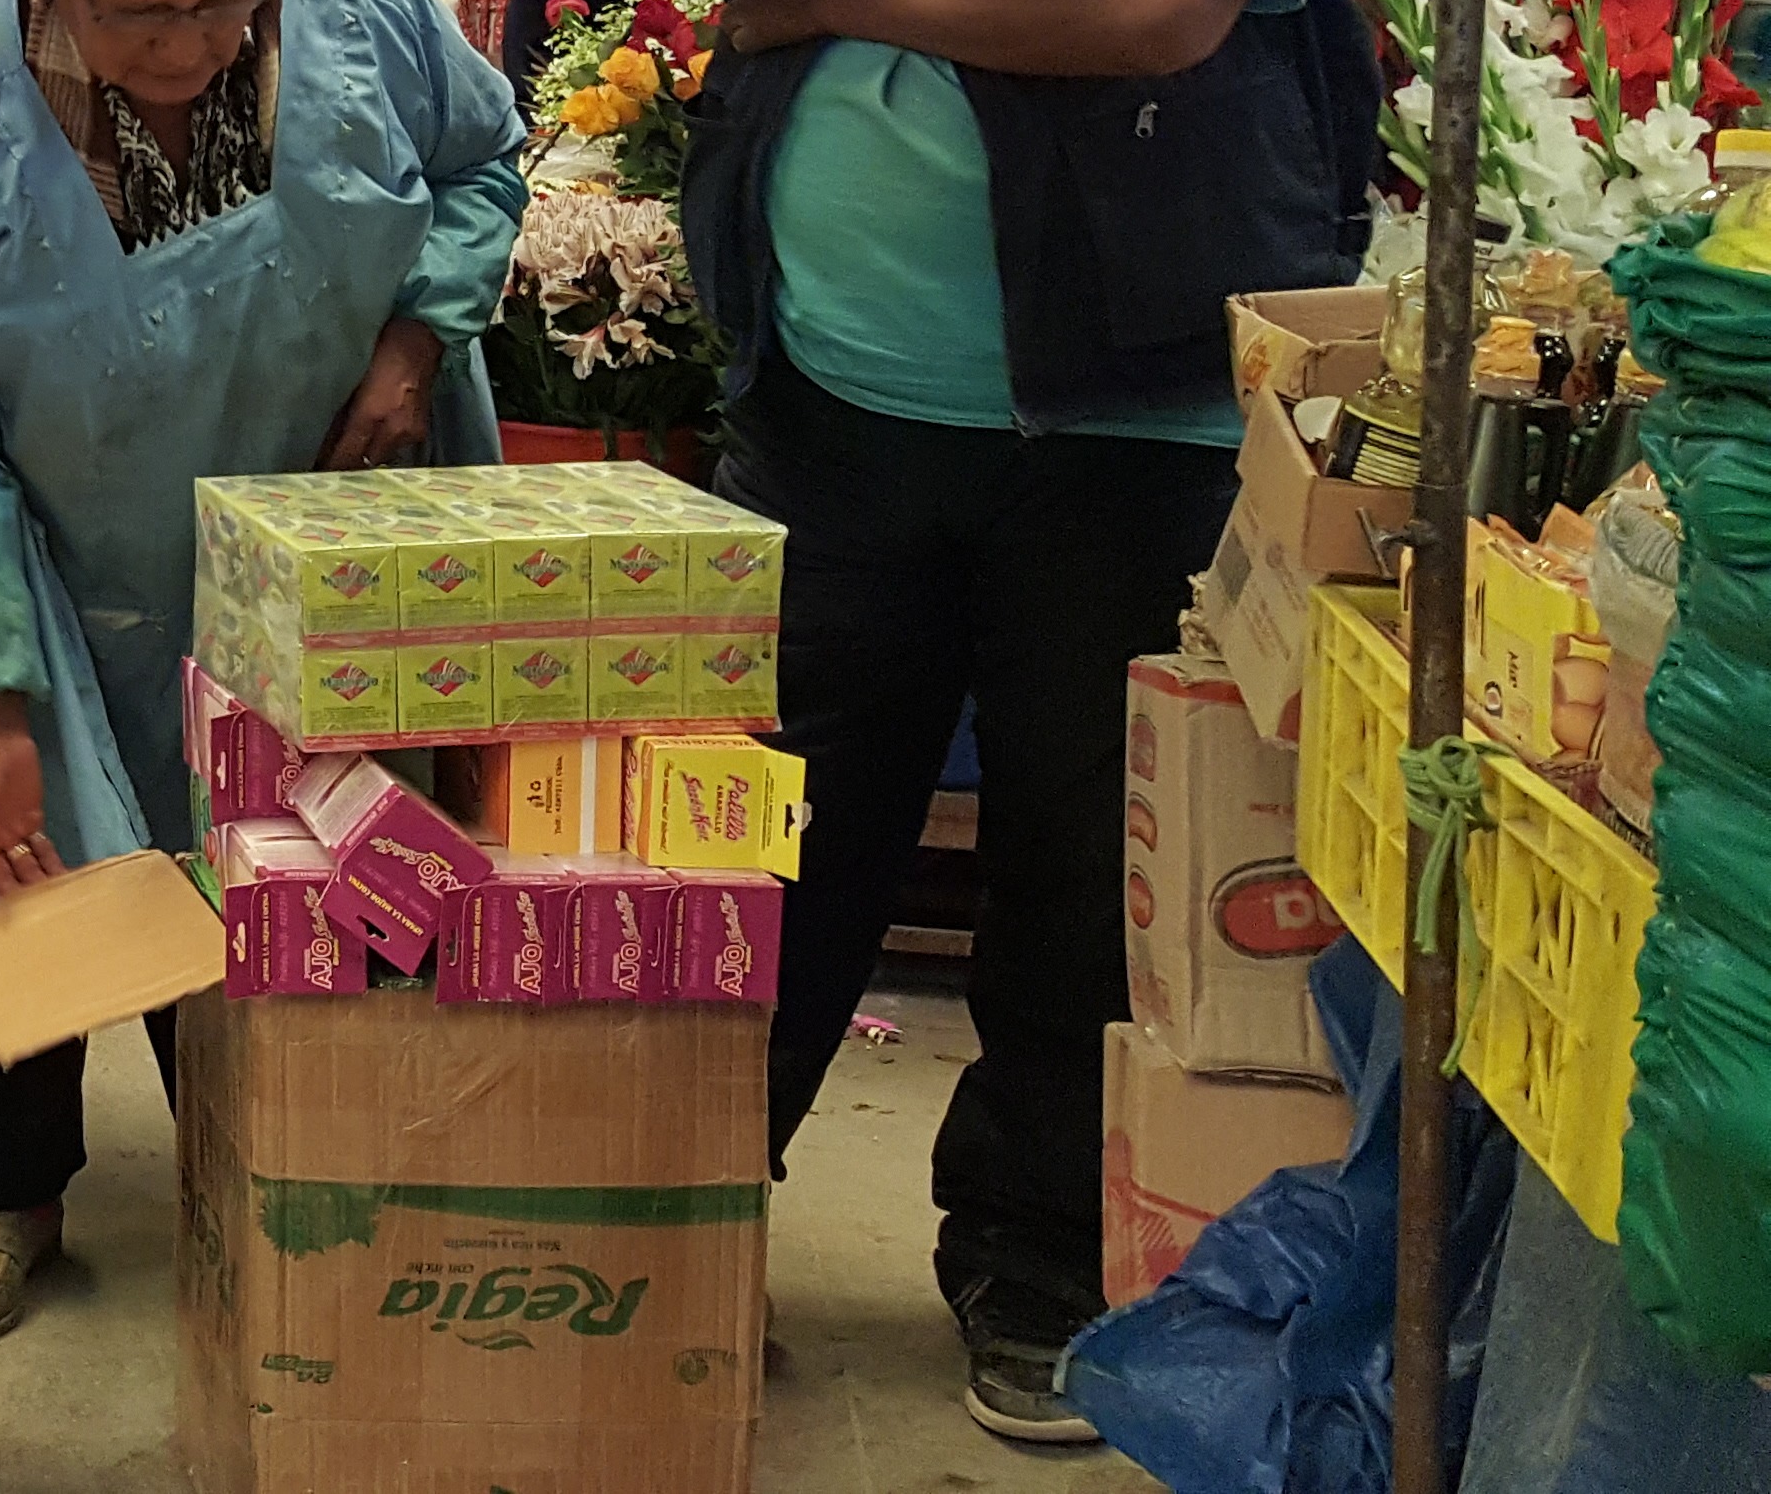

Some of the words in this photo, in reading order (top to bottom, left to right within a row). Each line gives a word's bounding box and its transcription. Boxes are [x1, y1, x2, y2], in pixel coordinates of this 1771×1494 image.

[715, 784, 723, 835] AMARILLO
[311, 937, 333, 990] AJO
[520, 943, 542, 995] AJO
[618, 942, 642, 994] AJO
[721, 943, 744, 997] AJO
[377, 1264, 650, 1336] Regia
